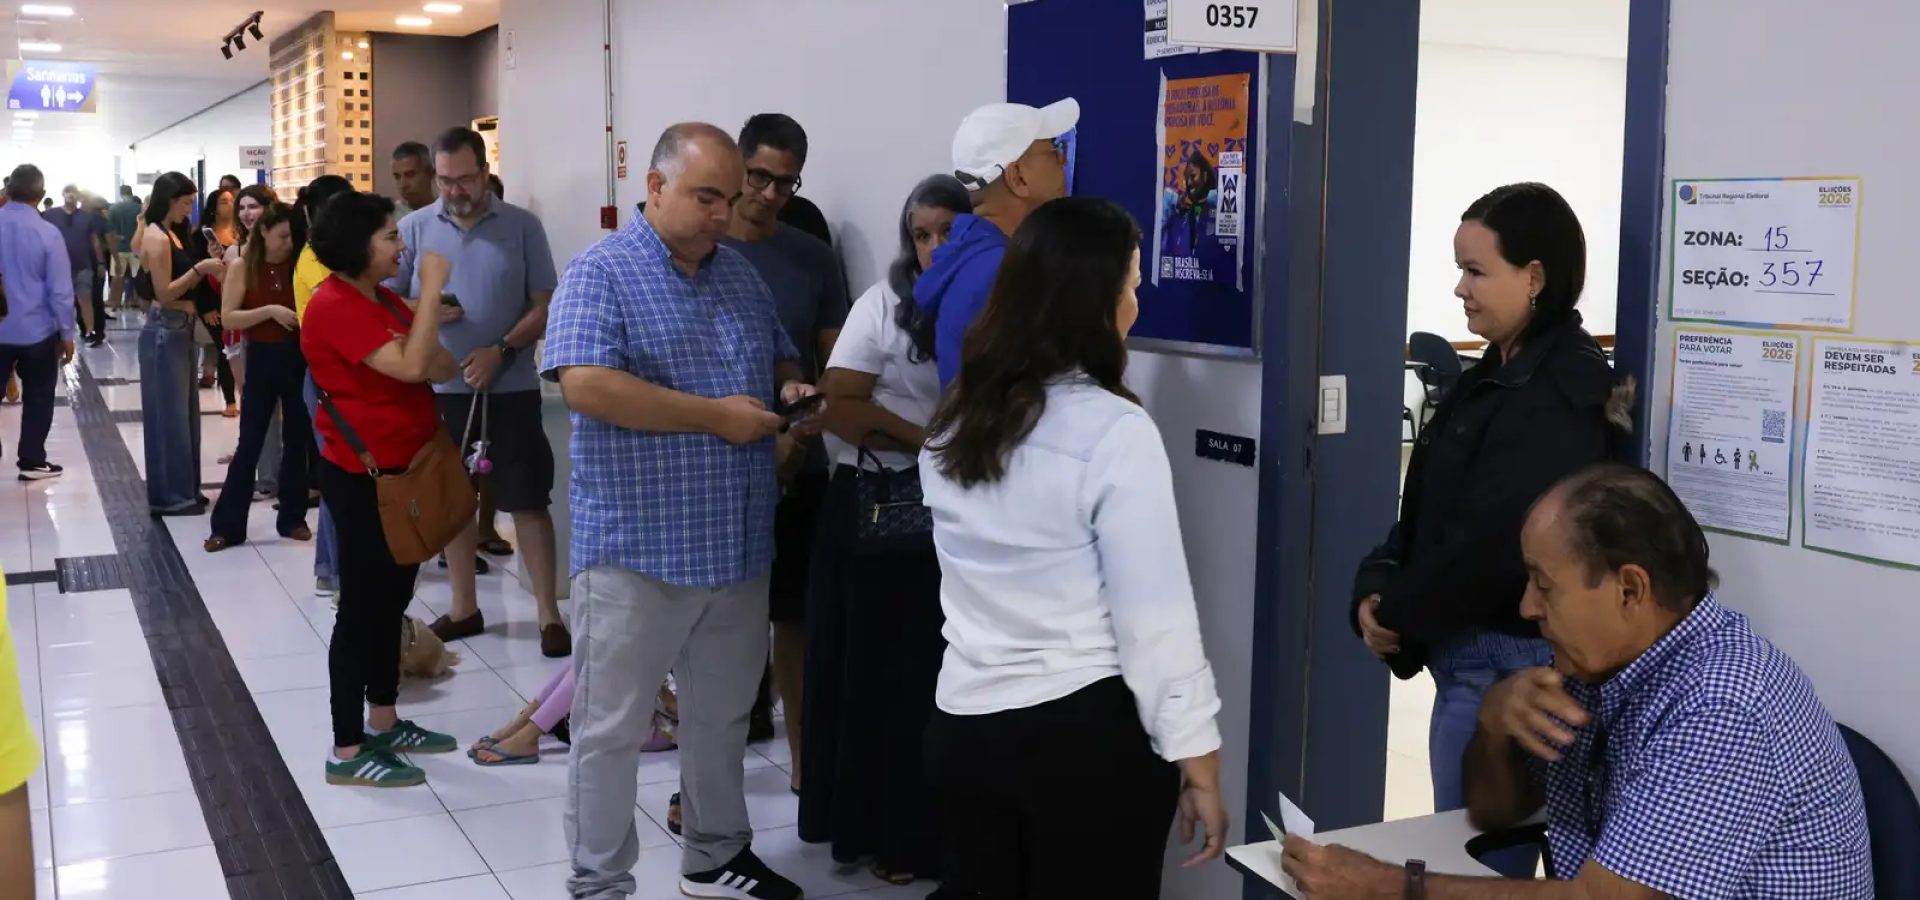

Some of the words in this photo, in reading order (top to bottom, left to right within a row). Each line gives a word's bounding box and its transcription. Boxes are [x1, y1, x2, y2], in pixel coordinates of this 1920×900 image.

[1206, 4, 1258, 28] 0357
[1819, 193, 1852, 204] 2026
[1684, 231, 1743, 247] ZONA:
[1764, 225, 1789, 252] 15
[1175, 257, 1200, 268] BRASÍLIA
[1682, 267, 1749, 291] SEÇÃO:
[1758, 260, 1823, 287] 357
[1680, 335, 1732, 345] PREFERÊNCIA
[1680, 343, 1701, 352] PARA
[1703, 345, 1732, 354] VOTAR
[1762, 348, 1792, 360] 2026
[1825, 351, 1860, 361] DEVEM
[1864, 354, 1885, 363] SER
[1824, 361, 1896, 375] RESPEITADAS
[1208, 438, 1228, 450] SALA
[1233, 443, 1241, 453] 07
